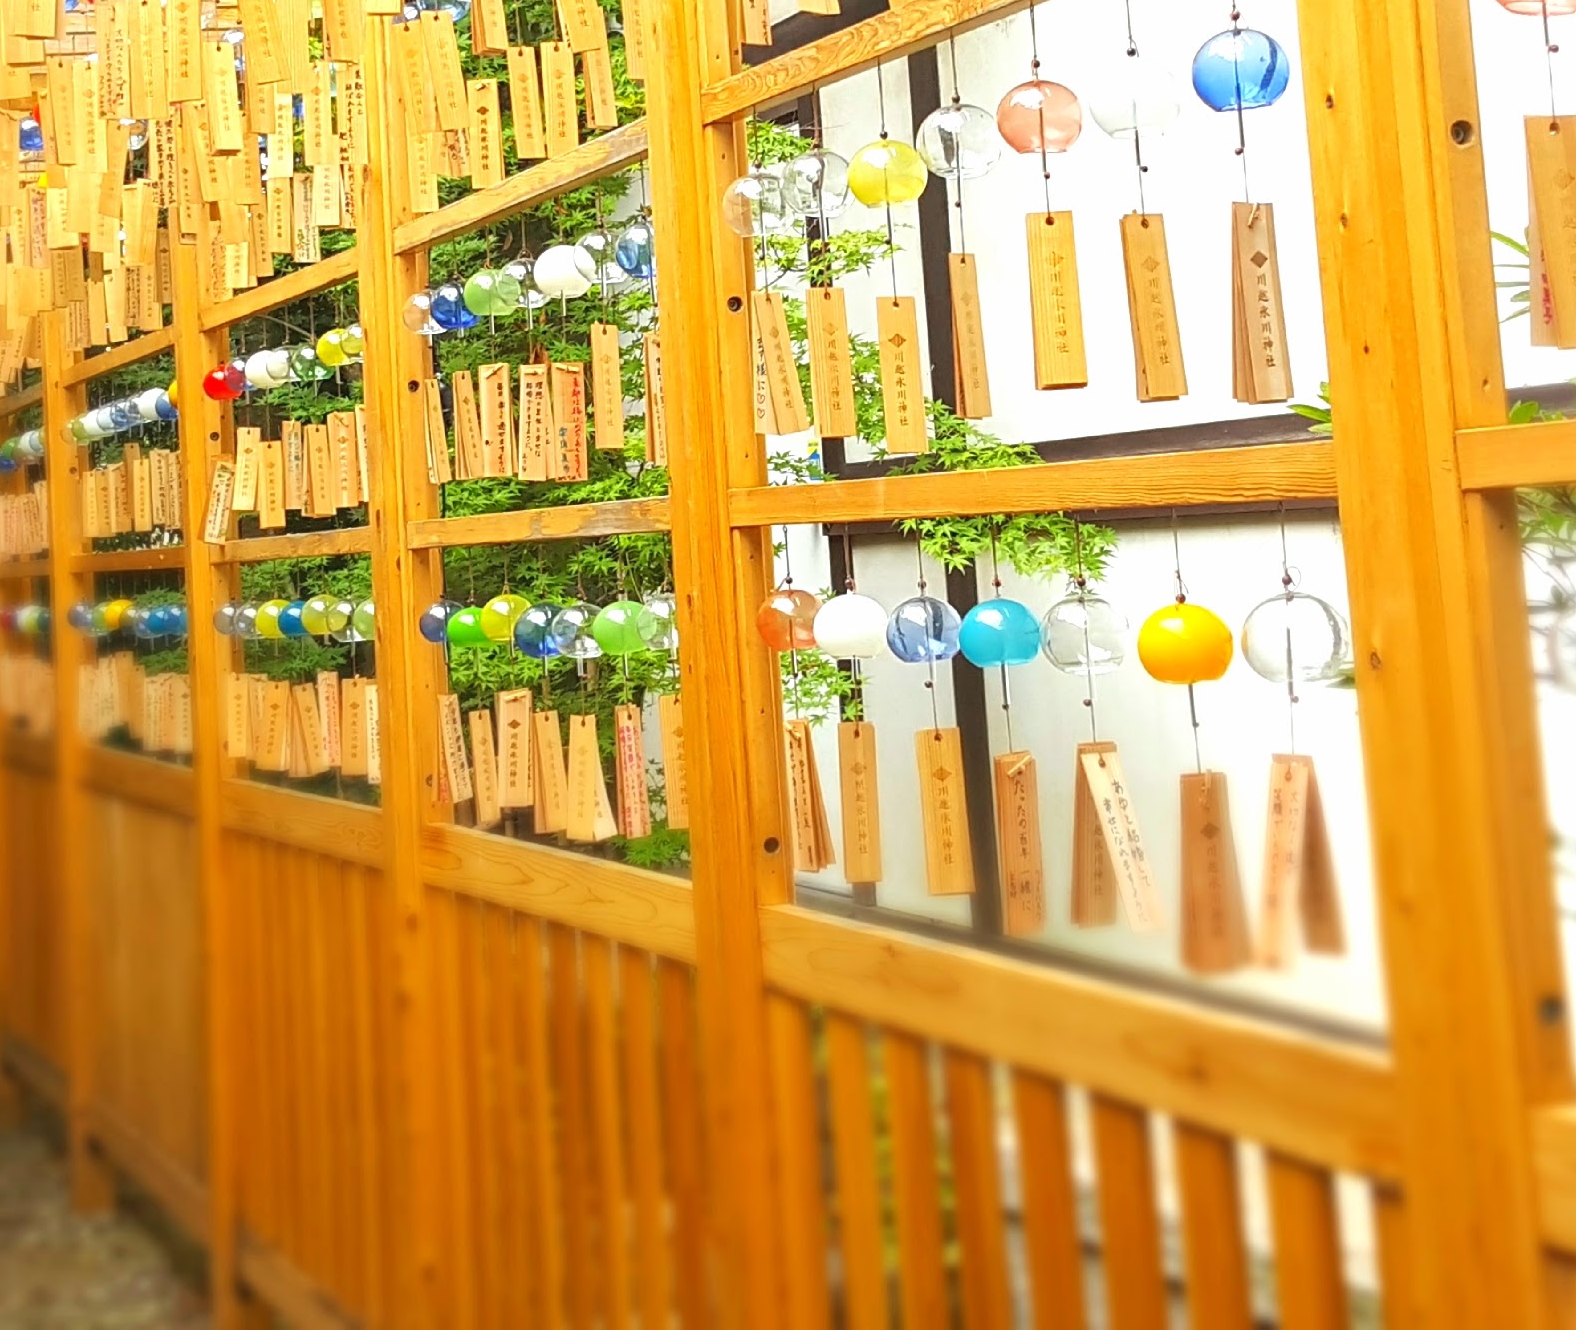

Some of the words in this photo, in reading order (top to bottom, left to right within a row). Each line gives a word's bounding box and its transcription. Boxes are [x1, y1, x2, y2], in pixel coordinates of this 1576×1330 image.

[479, 116, 489, 171] 川越氷川神社
[1050, 270, 1069, 355] 川越氷川神社
[1147, 277, 1171, 367] 川越氷川神社
[1257, 274, 1276, 368] 川越氷川神社
[826, 339, 843, 412] 川越氷川神社
[894, 351, 910, 427] 川越氷川神社
[509, 732, 517, 789] 川越氷川神社
[854, 780, 869, 855] 川越氷川神社
[936, 786, 954, 866] 川越氷川神社
